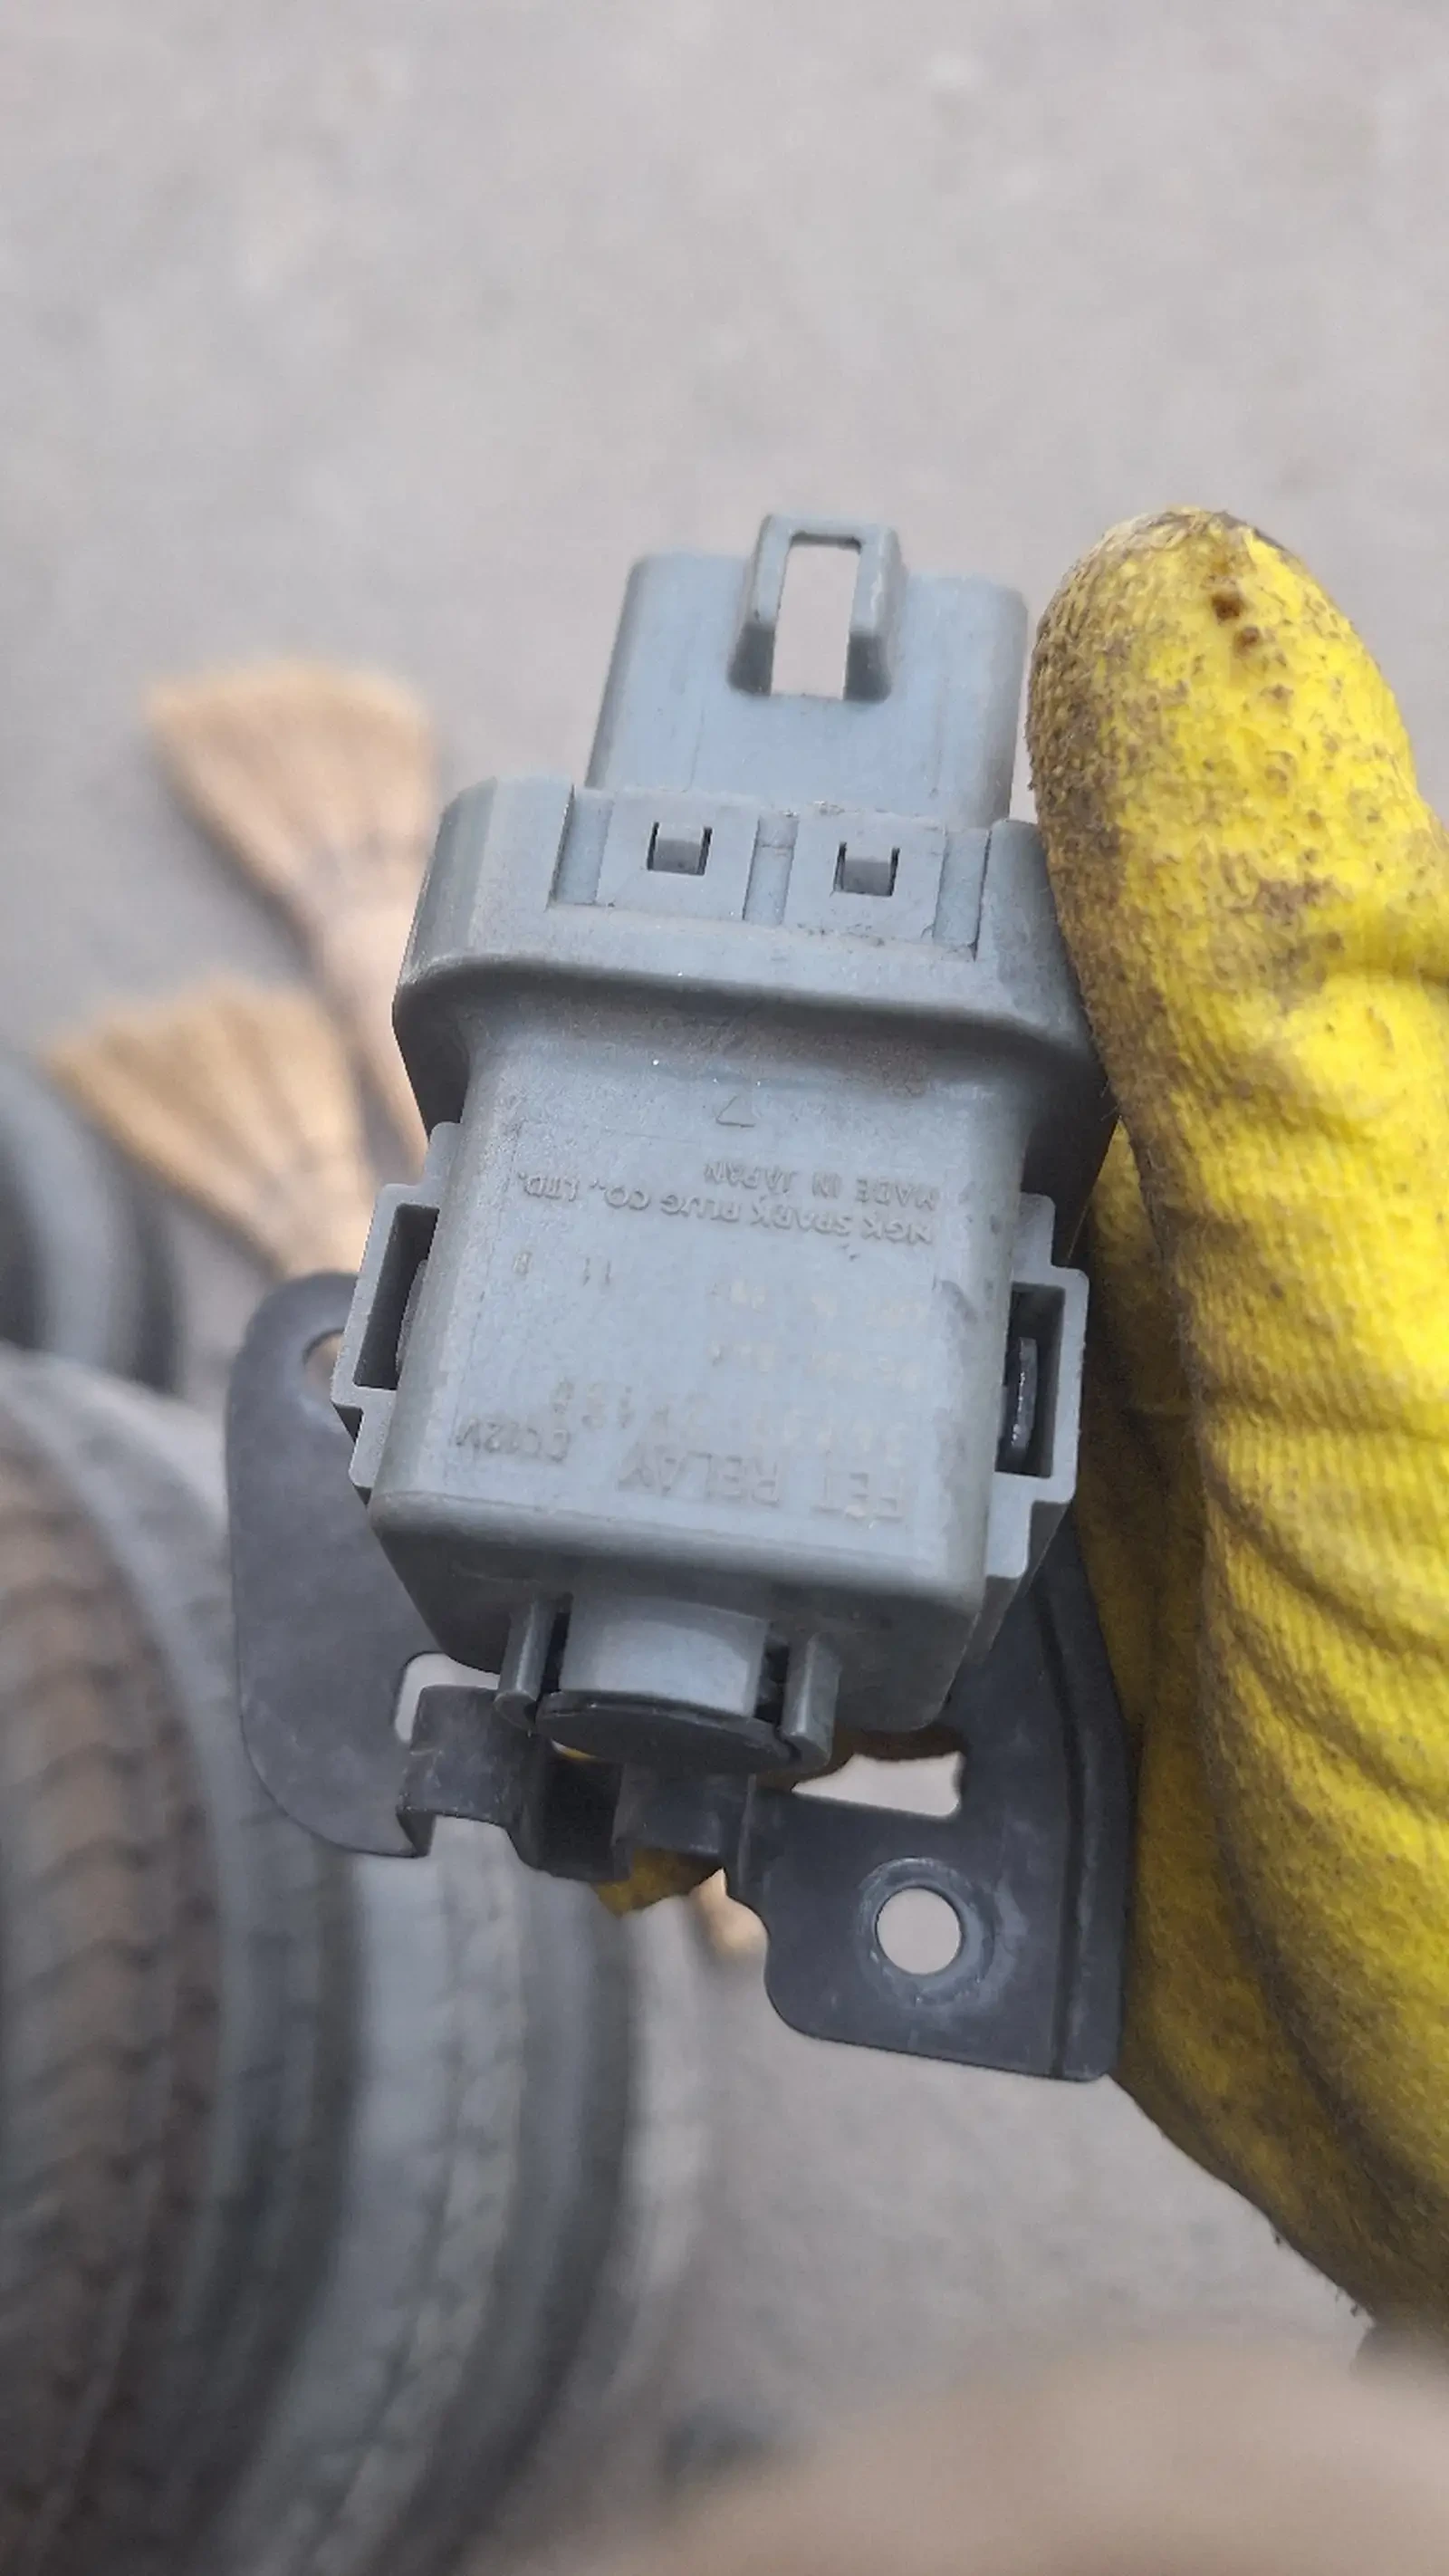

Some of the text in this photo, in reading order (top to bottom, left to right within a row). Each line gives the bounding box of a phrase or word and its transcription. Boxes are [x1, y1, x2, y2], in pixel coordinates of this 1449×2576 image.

[704, 1162, 937, 1212] MADE IN JAPAN
[660, 1193, 741, 1225] PLUG
[751, 1202, 853, 1237] SPARK
[860, 1217, 935, 1246] NGK
[616, 1446, 905, 1526] FET RELAY
